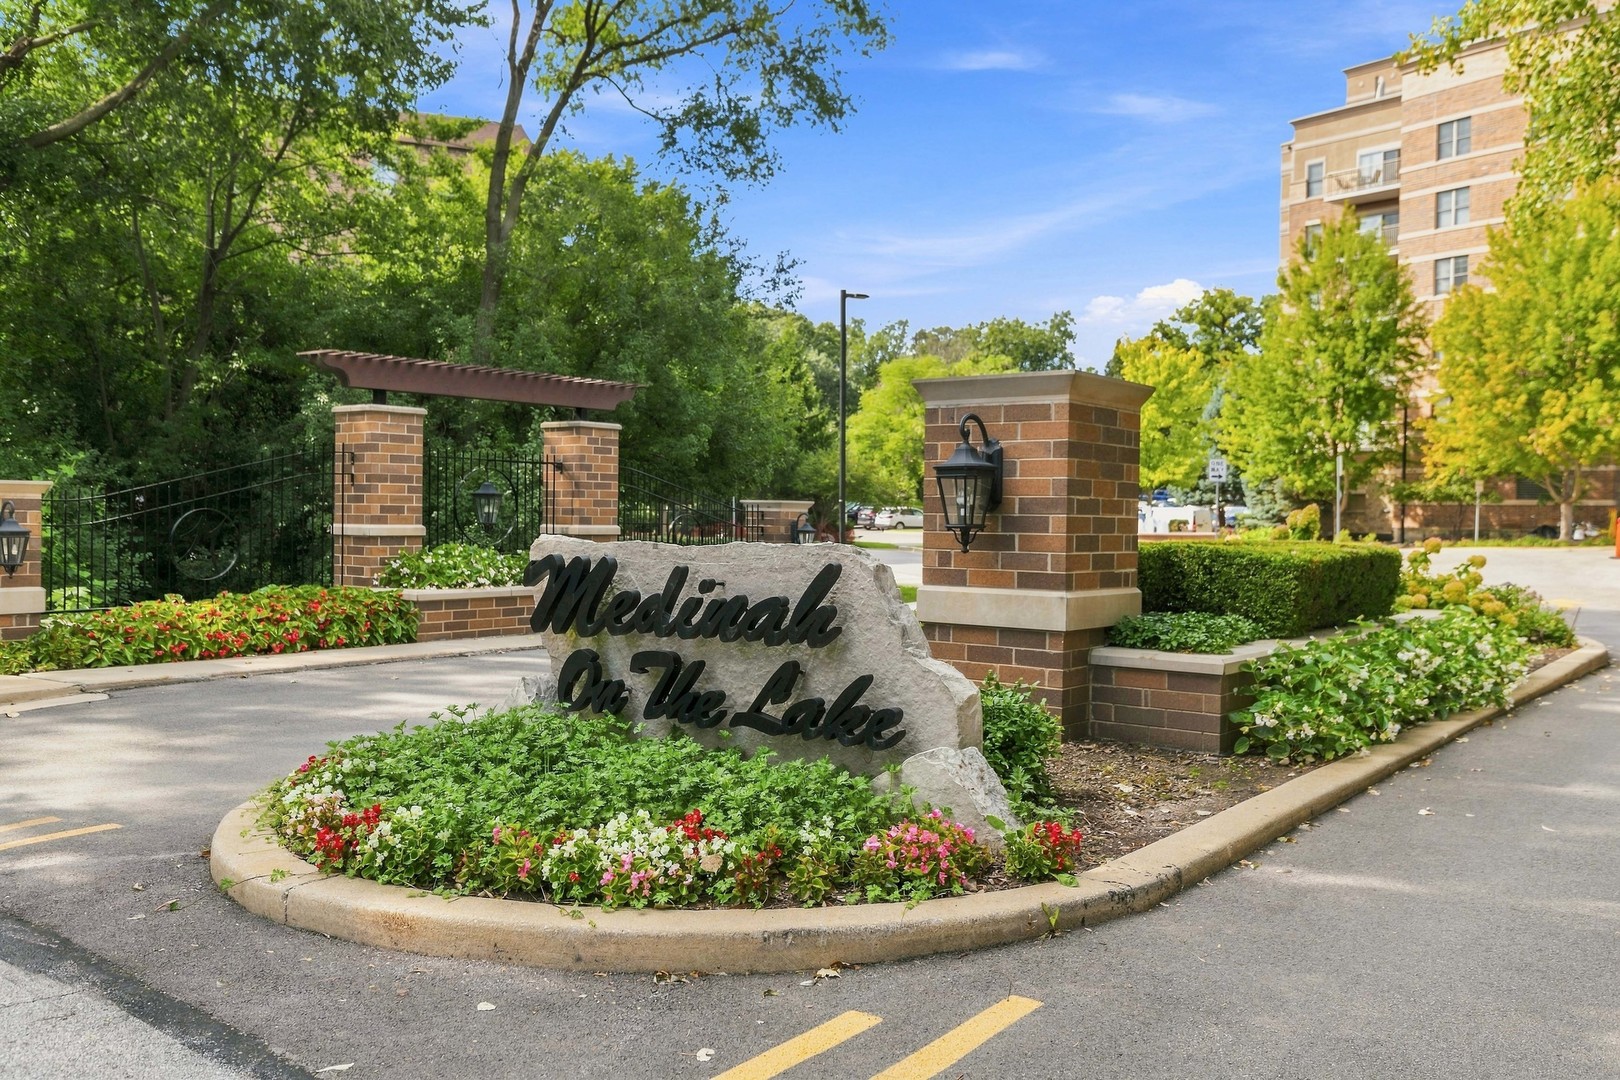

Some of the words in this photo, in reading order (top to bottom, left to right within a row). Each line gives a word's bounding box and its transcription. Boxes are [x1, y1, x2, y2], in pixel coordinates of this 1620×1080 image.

[523, 554, 842, 648] Medinah
[558, 648, 630, 715] On
[630, 650, 728, 729] The
[729, 660, 906, 751] Lake
